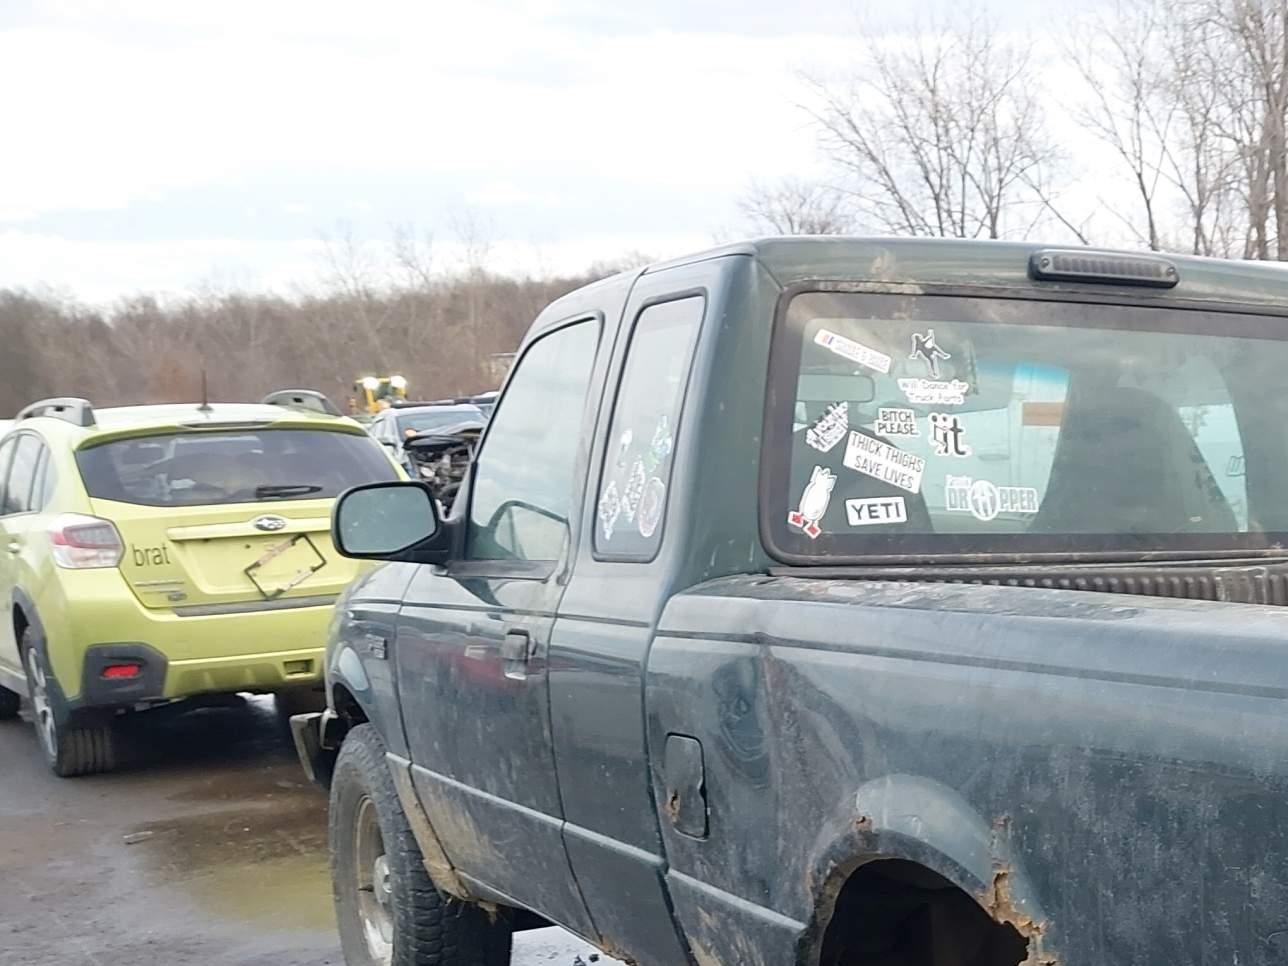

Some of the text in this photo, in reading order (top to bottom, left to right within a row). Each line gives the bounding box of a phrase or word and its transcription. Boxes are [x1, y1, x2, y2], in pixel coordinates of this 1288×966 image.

[881, 410, 912, 422] BITCH
[877, 422, 918, 435] PLEASE
[850, 433, 922, 472] THICK THIGHS
[854, 455, 914, 489] SAVE LIVES
[851, 502, 901, 520] YETI
[132, 543, 171, 567] brat
